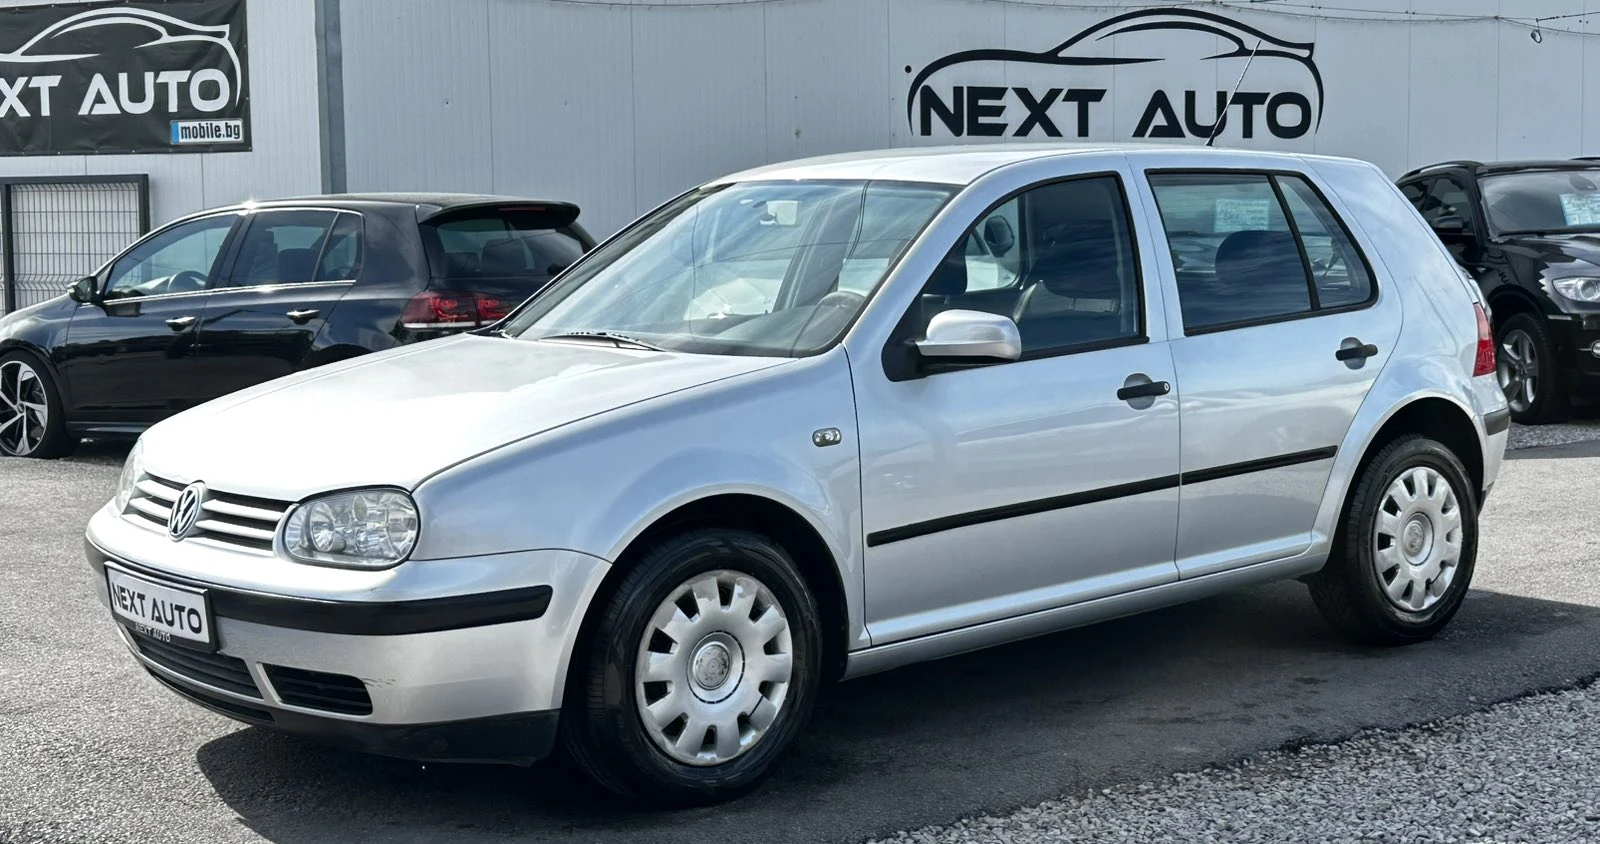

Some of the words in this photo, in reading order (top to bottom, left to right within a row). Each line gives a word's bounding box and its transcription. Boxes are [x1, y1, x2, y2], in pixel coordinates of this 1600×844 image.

[78, 69, 230, 115] AUTO
[920, 85, 1107, 138] NEXT
[1131, 89, 1312, 140] AUTO
[180, 122, 241, 140] mobile.bg
[112, 582, 146, 618] NEXT
[151, 597, 202, 635] AUTO
[153, 627, 171, 642] AUTO
